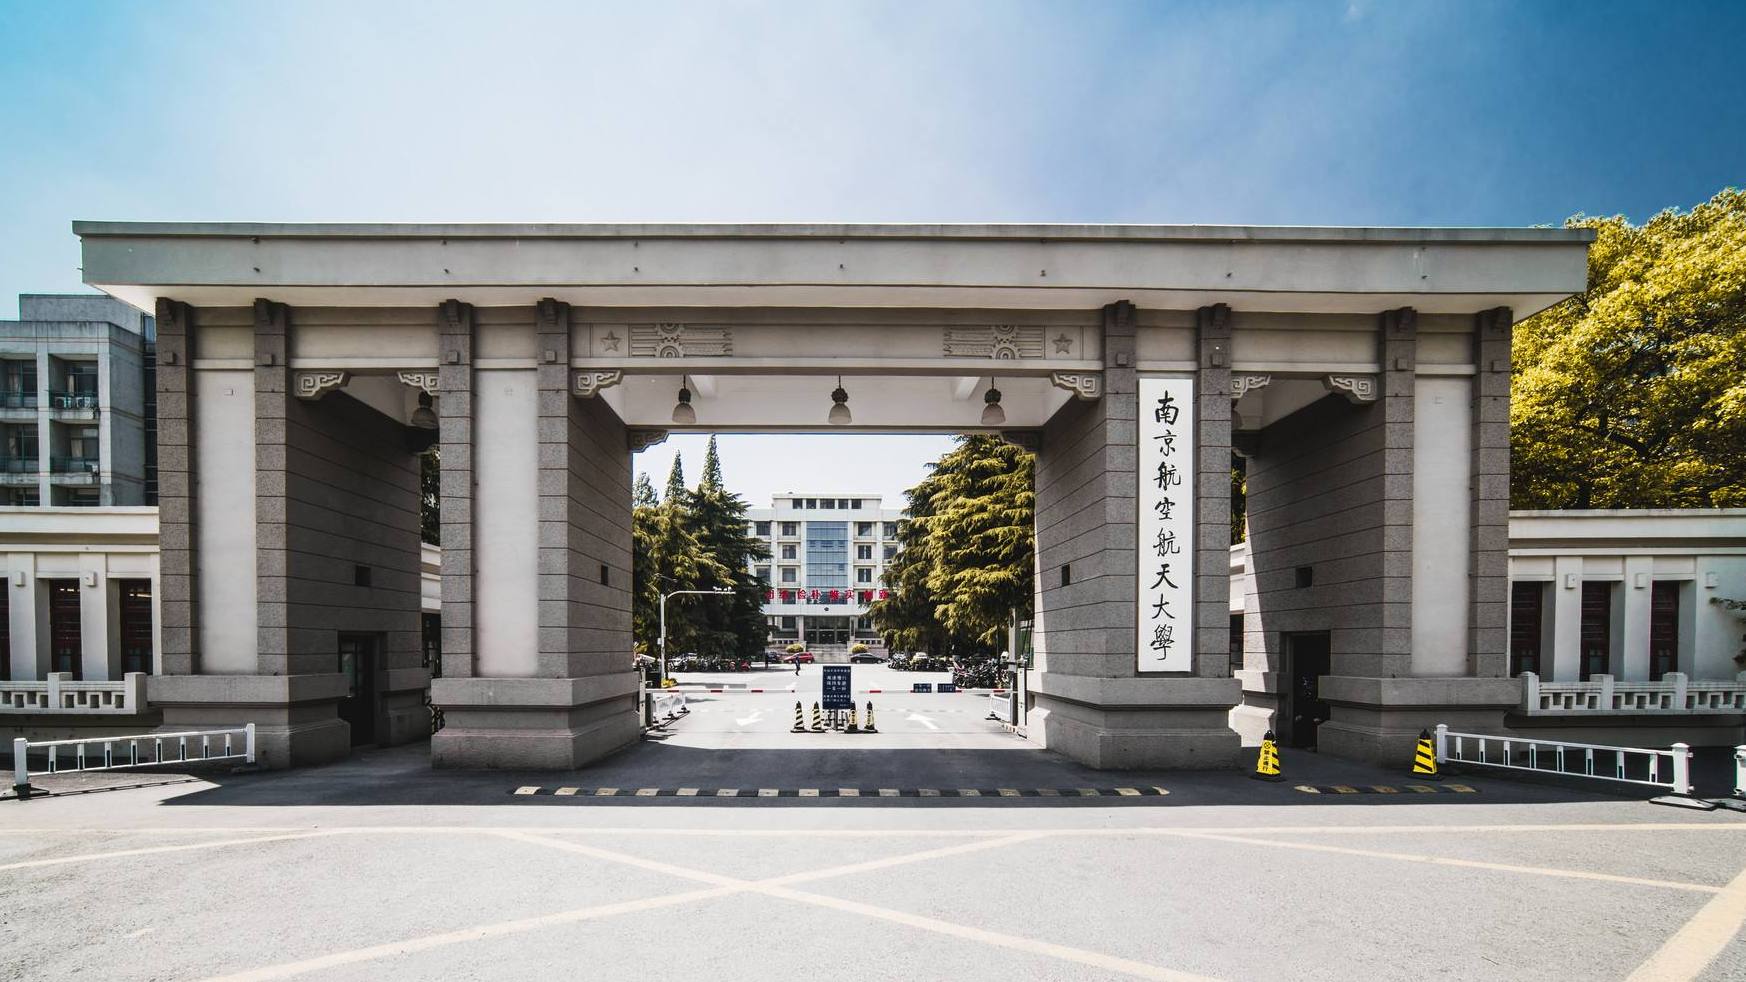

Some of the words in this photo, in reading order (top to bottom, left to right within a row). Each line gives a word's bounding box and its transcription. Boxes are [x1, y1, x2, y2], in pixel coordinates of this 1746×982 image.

[1150, 390, 1181, 661] 南京航空航天大學
